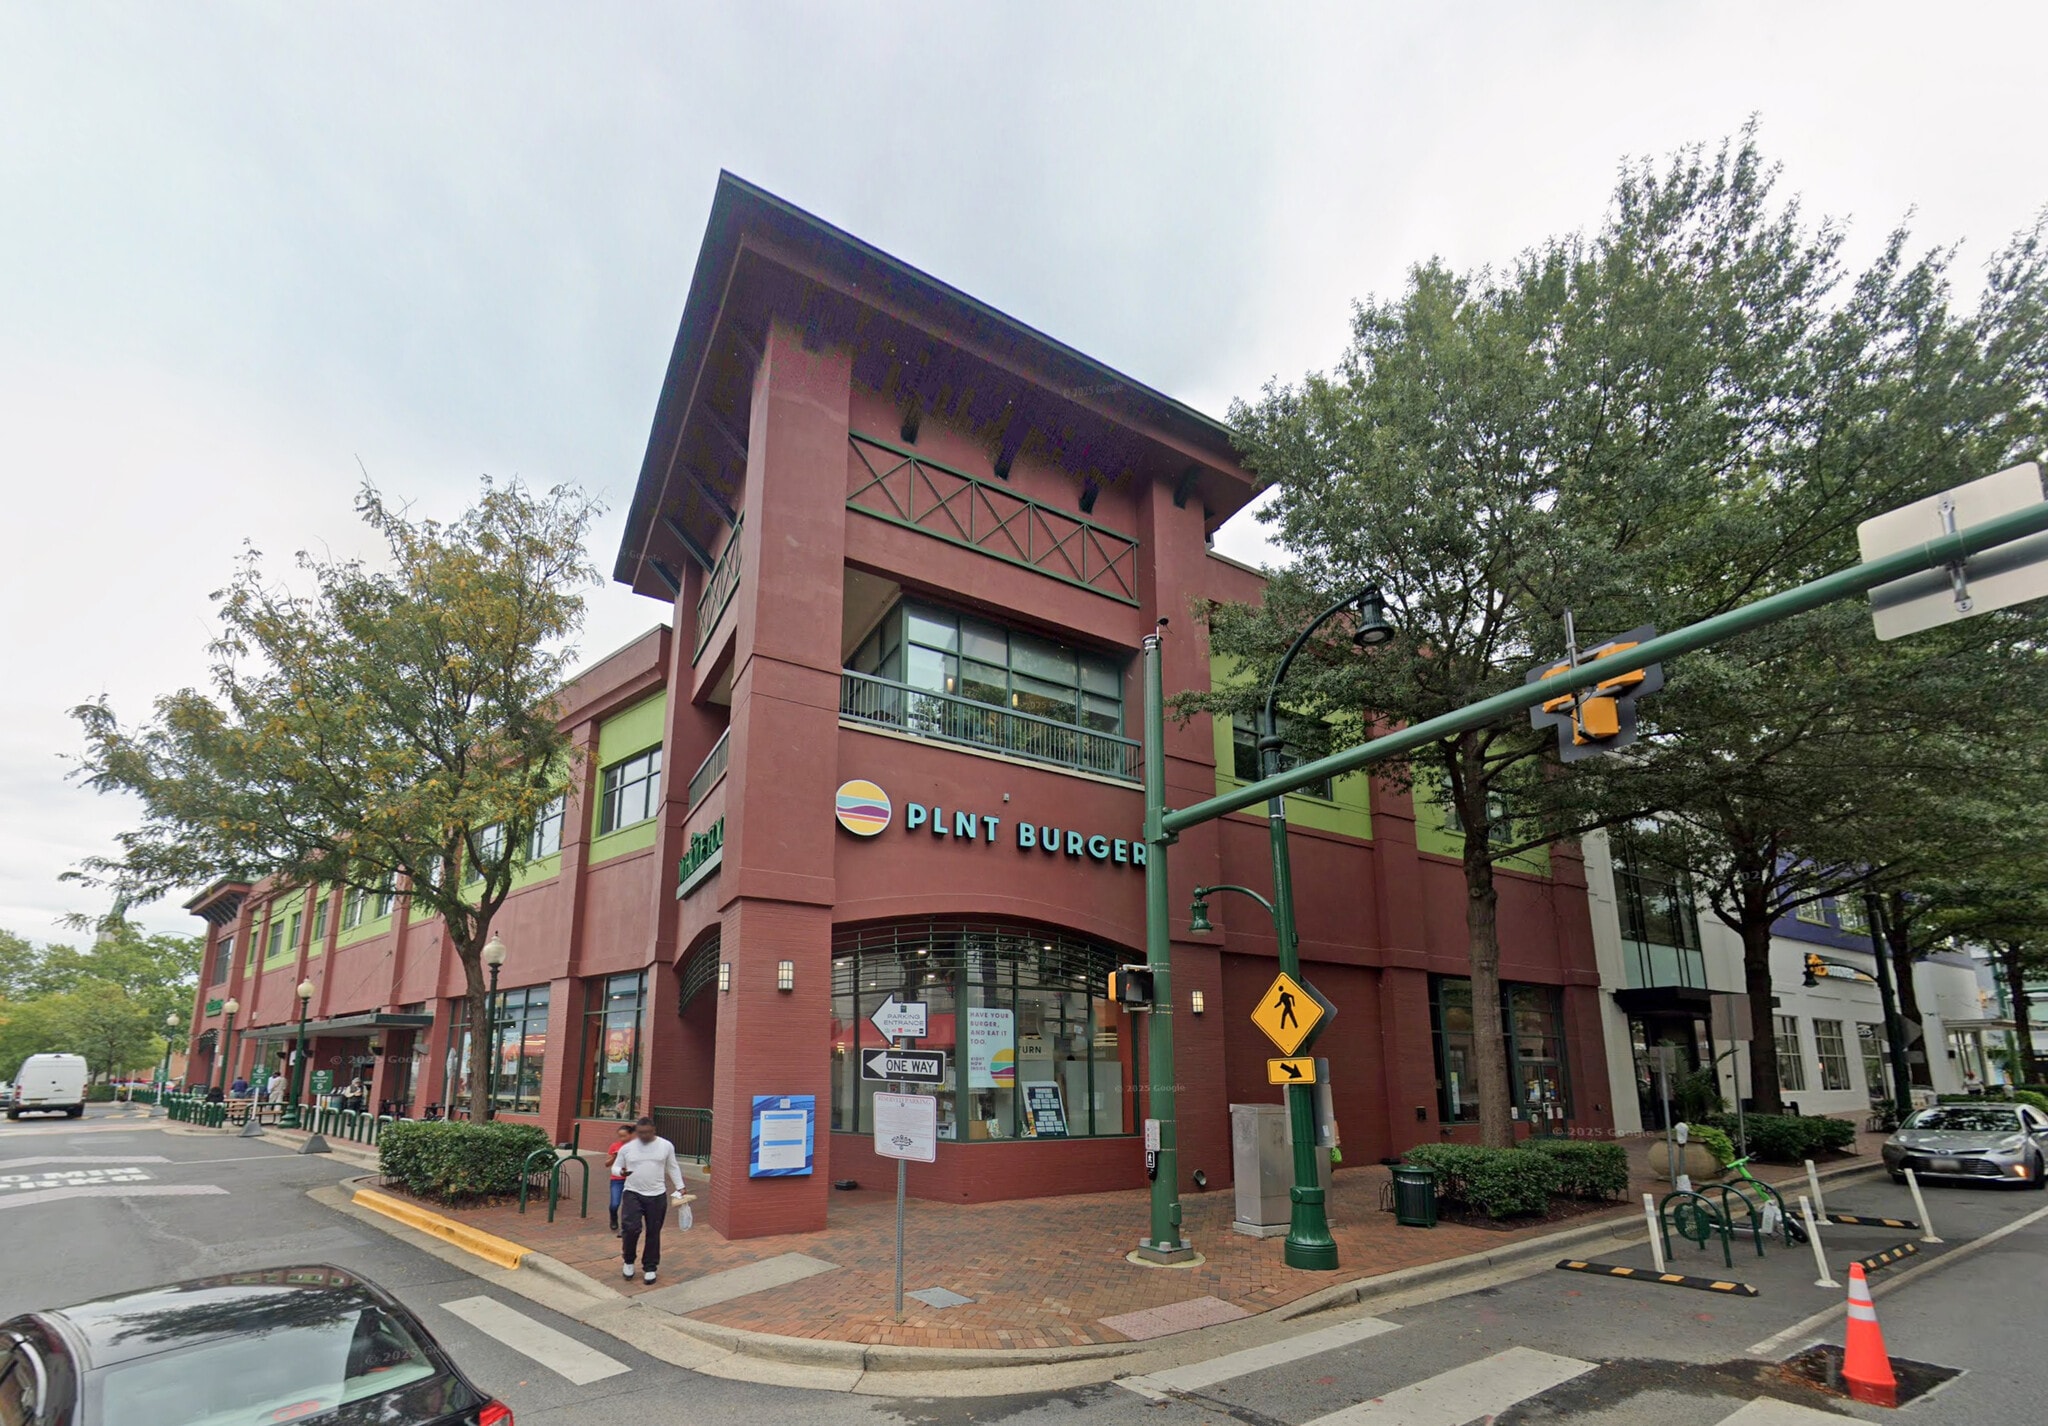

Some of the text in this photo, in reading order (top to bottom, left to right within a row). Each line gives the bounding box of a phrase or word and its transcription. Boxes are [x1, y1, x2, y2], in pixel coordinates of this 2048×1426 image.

[906, 802, 1147, 867] PLNT BURGER
[884, 1019, 924, 1027] ENTRANCE
[886, 1058, 935, 1075] ONE WAY
[43, 1167, 142, 1180] MIN
